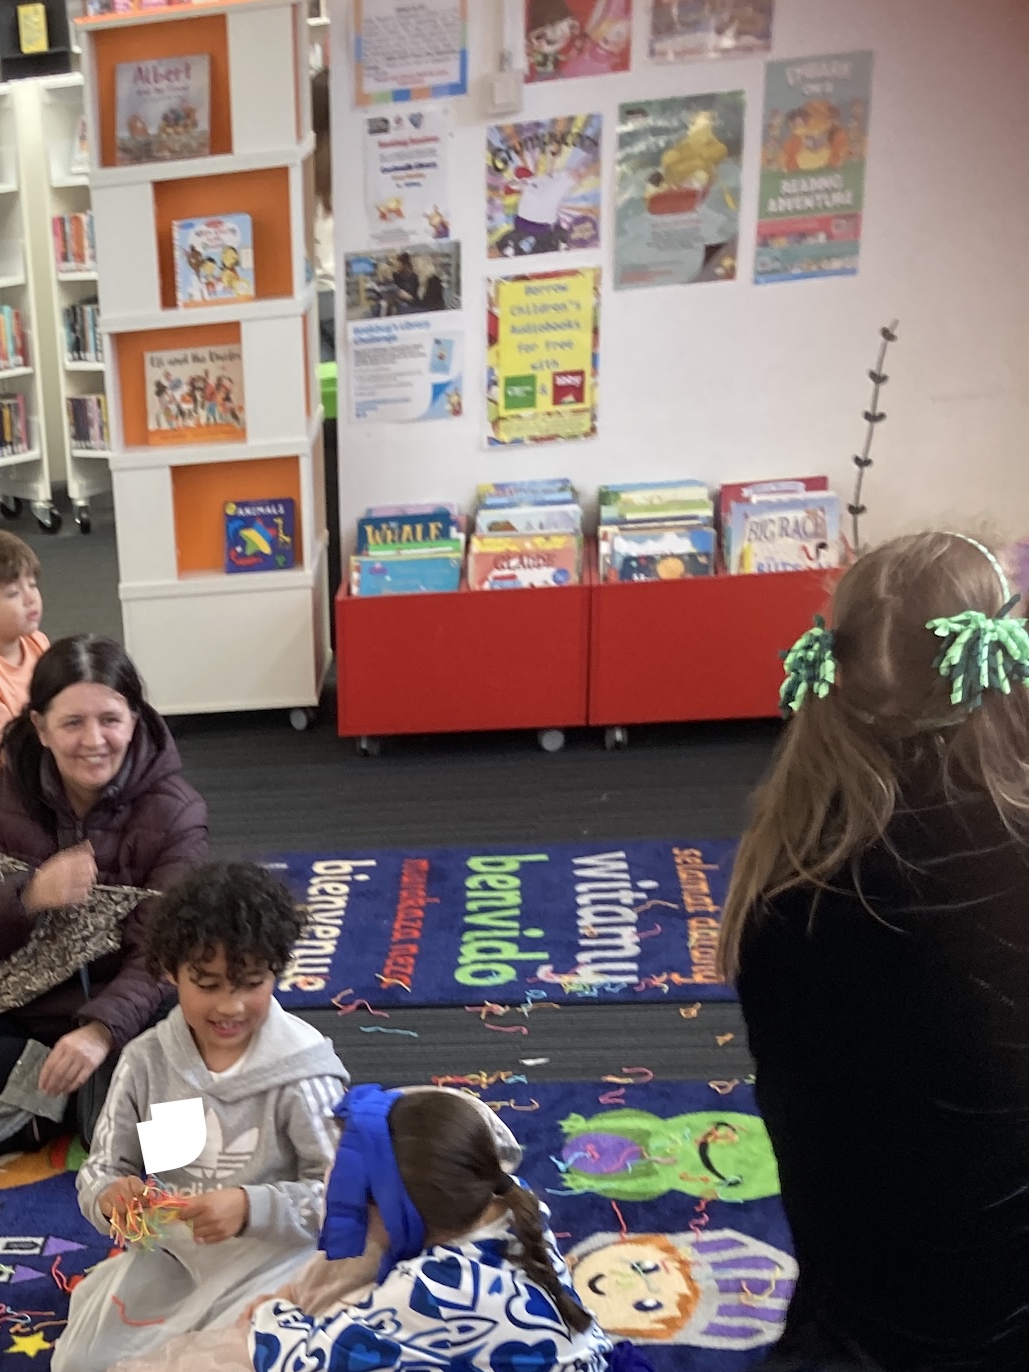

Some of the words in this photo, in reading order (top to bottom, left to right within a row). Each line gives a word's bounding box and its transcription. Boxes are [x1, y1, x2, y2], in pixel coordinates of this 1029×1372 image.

[133, 61, 191, 85] Albert
[768, 189, 853, 212] ADVENTURE
[781, 173, 844, 194] READING
[278, 859, 377, 992] bienvenue
[454, 853, 549, 987] benvido
[537, 850, 660, 984] witamy
